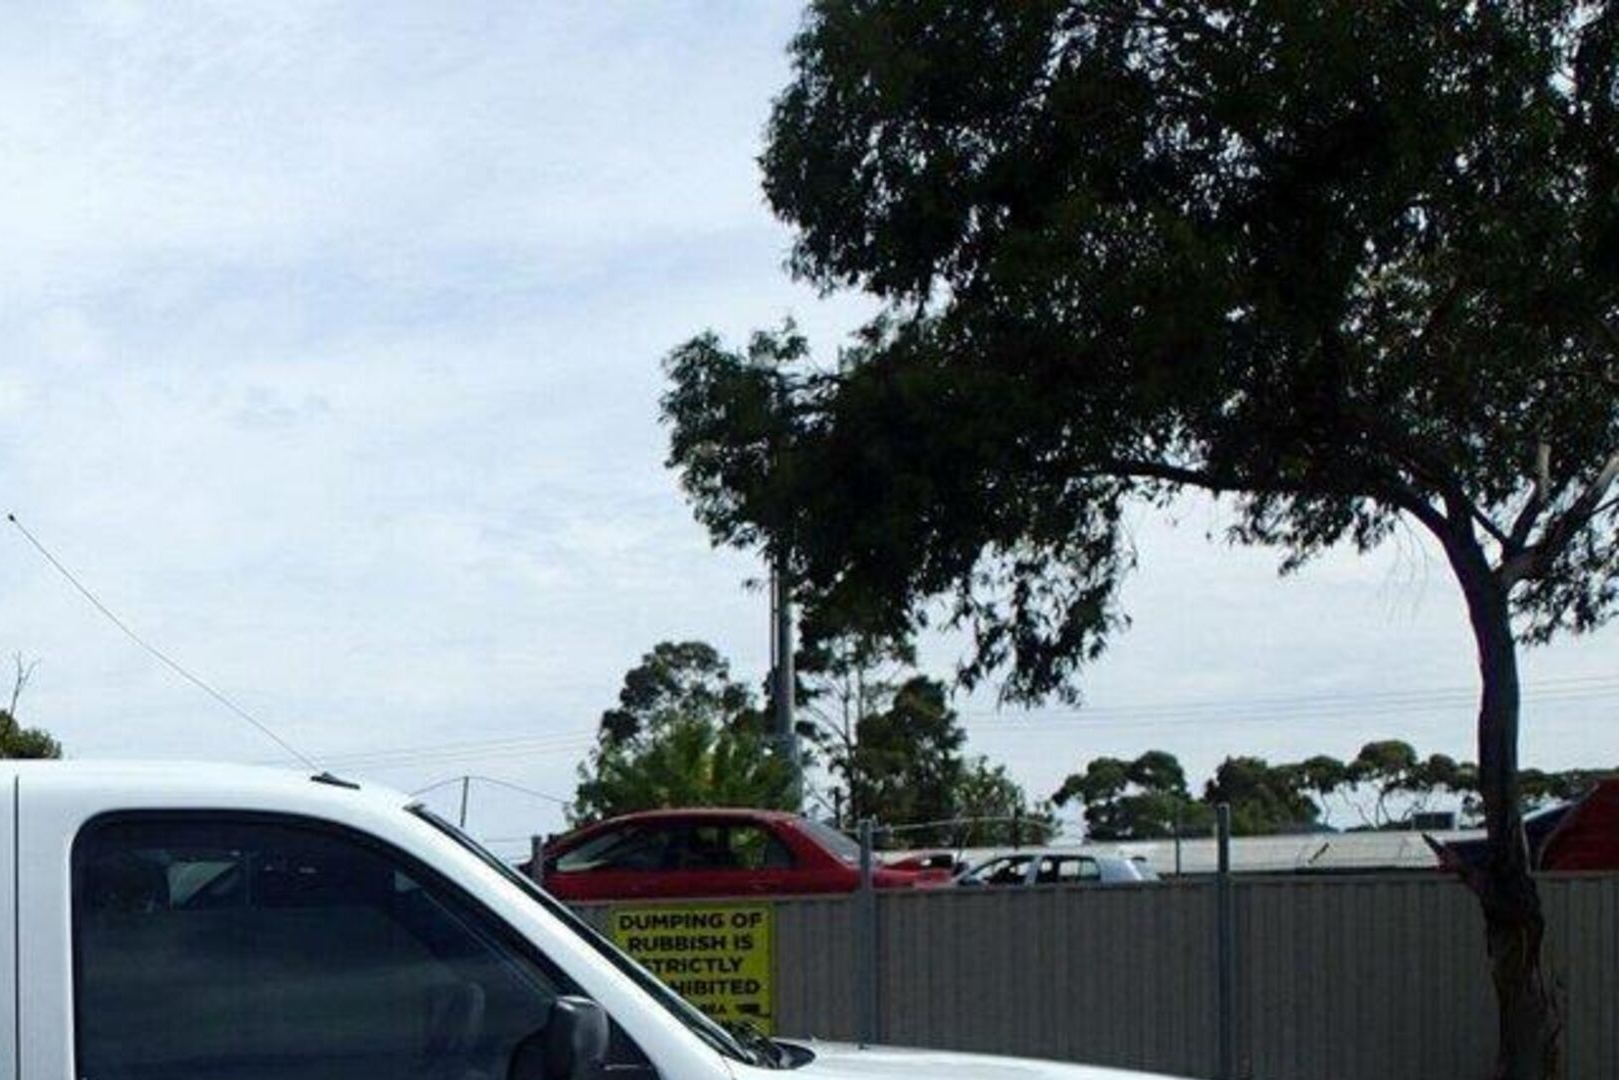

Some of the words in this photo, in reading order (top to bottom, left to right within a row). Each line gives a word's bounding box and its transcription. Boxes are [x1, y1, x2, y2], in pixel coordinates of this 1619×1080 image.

[619, 912, 724, 930] DUMPING
[731, 911, 763, 928] OF
[628, 934, 726, 951] RUBBISH
[734, 933, 754, 950] IS
[670, 979, 761, 996] HIBITED
